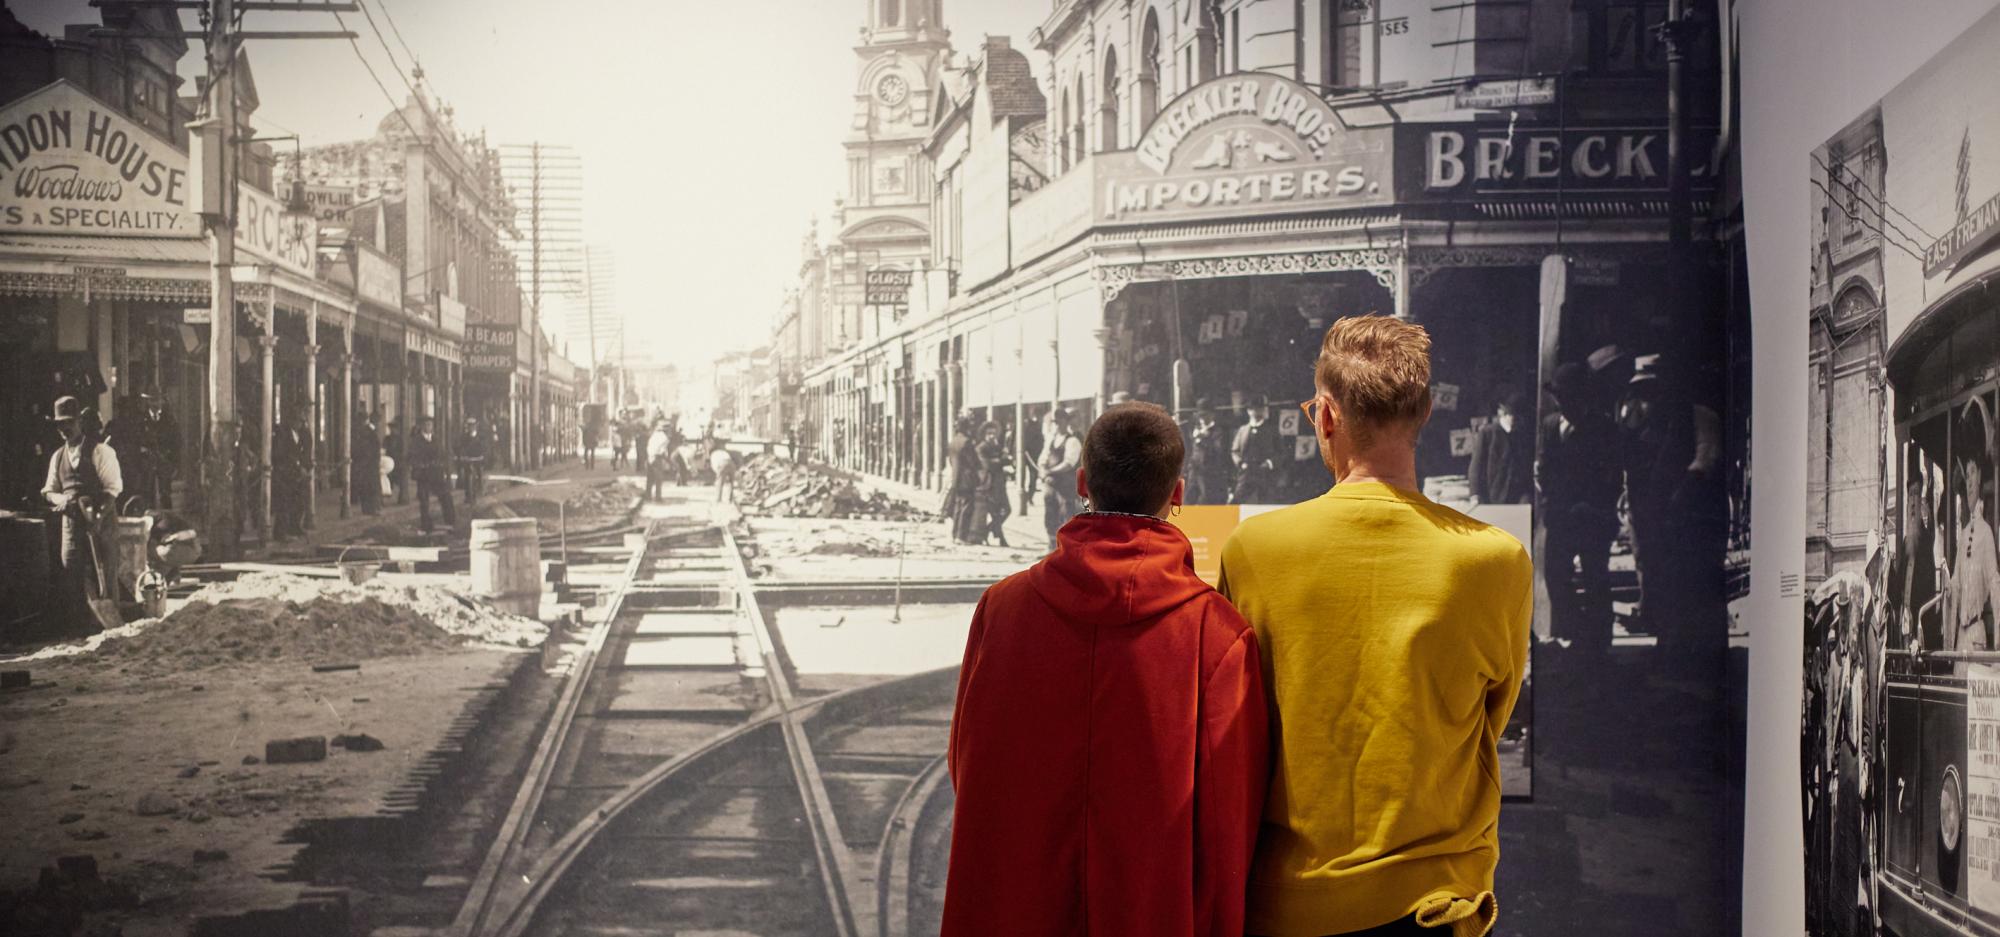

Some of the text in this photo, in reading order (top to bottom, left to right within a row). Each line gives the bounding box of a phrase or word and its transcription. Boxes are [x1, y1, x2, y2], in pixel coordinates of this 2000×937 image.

[1137, 78, 1261, 176] BRECKLER
[84, 109, 187, 207] HOUSE
[15, 164, 122, 202] Woodrows
[1104, 165, 1379, 220] IMPORTERS.
[0, 206, 24, 226] S
[49, 205, 184, 230] SPECIALITY.
[1926, 230, 1954, 273] EAST
[476, 327, 514, 346] BEARD
[1281, 415, 1297, 431] 6
[1455, 436, 1467, 450] 7
